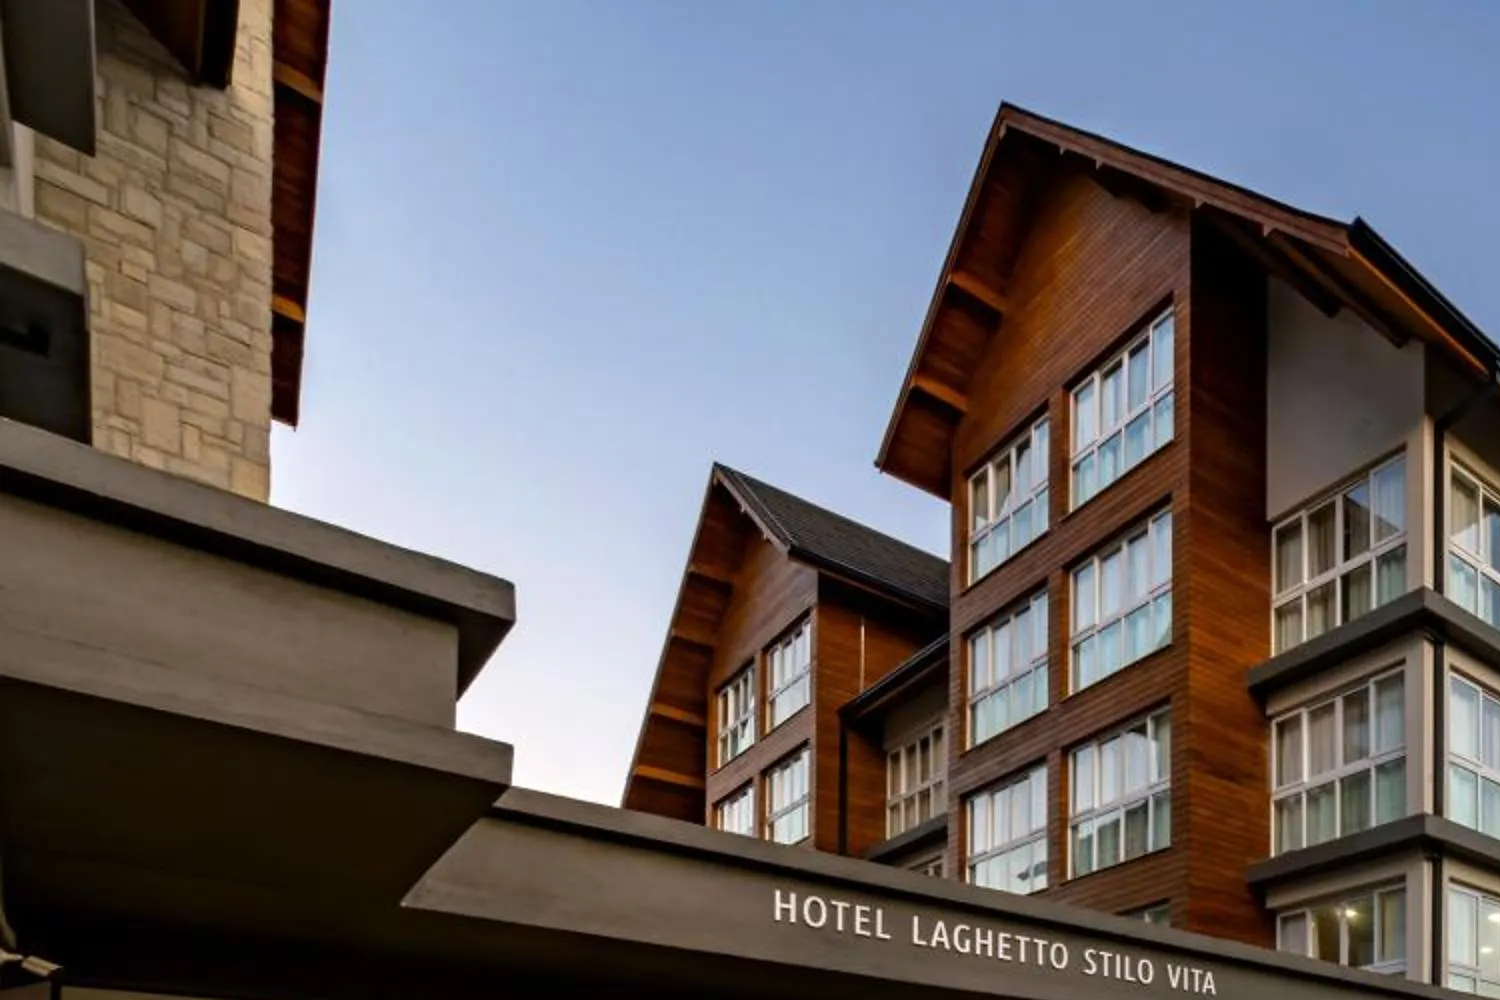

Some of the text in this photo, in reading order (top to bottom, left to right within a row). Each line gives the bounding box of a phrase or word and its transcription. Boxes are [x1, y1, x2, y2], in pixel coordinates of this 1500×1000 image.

[773, 889, 1217, 996] HOTEL LAGHETTO STILO VITA
